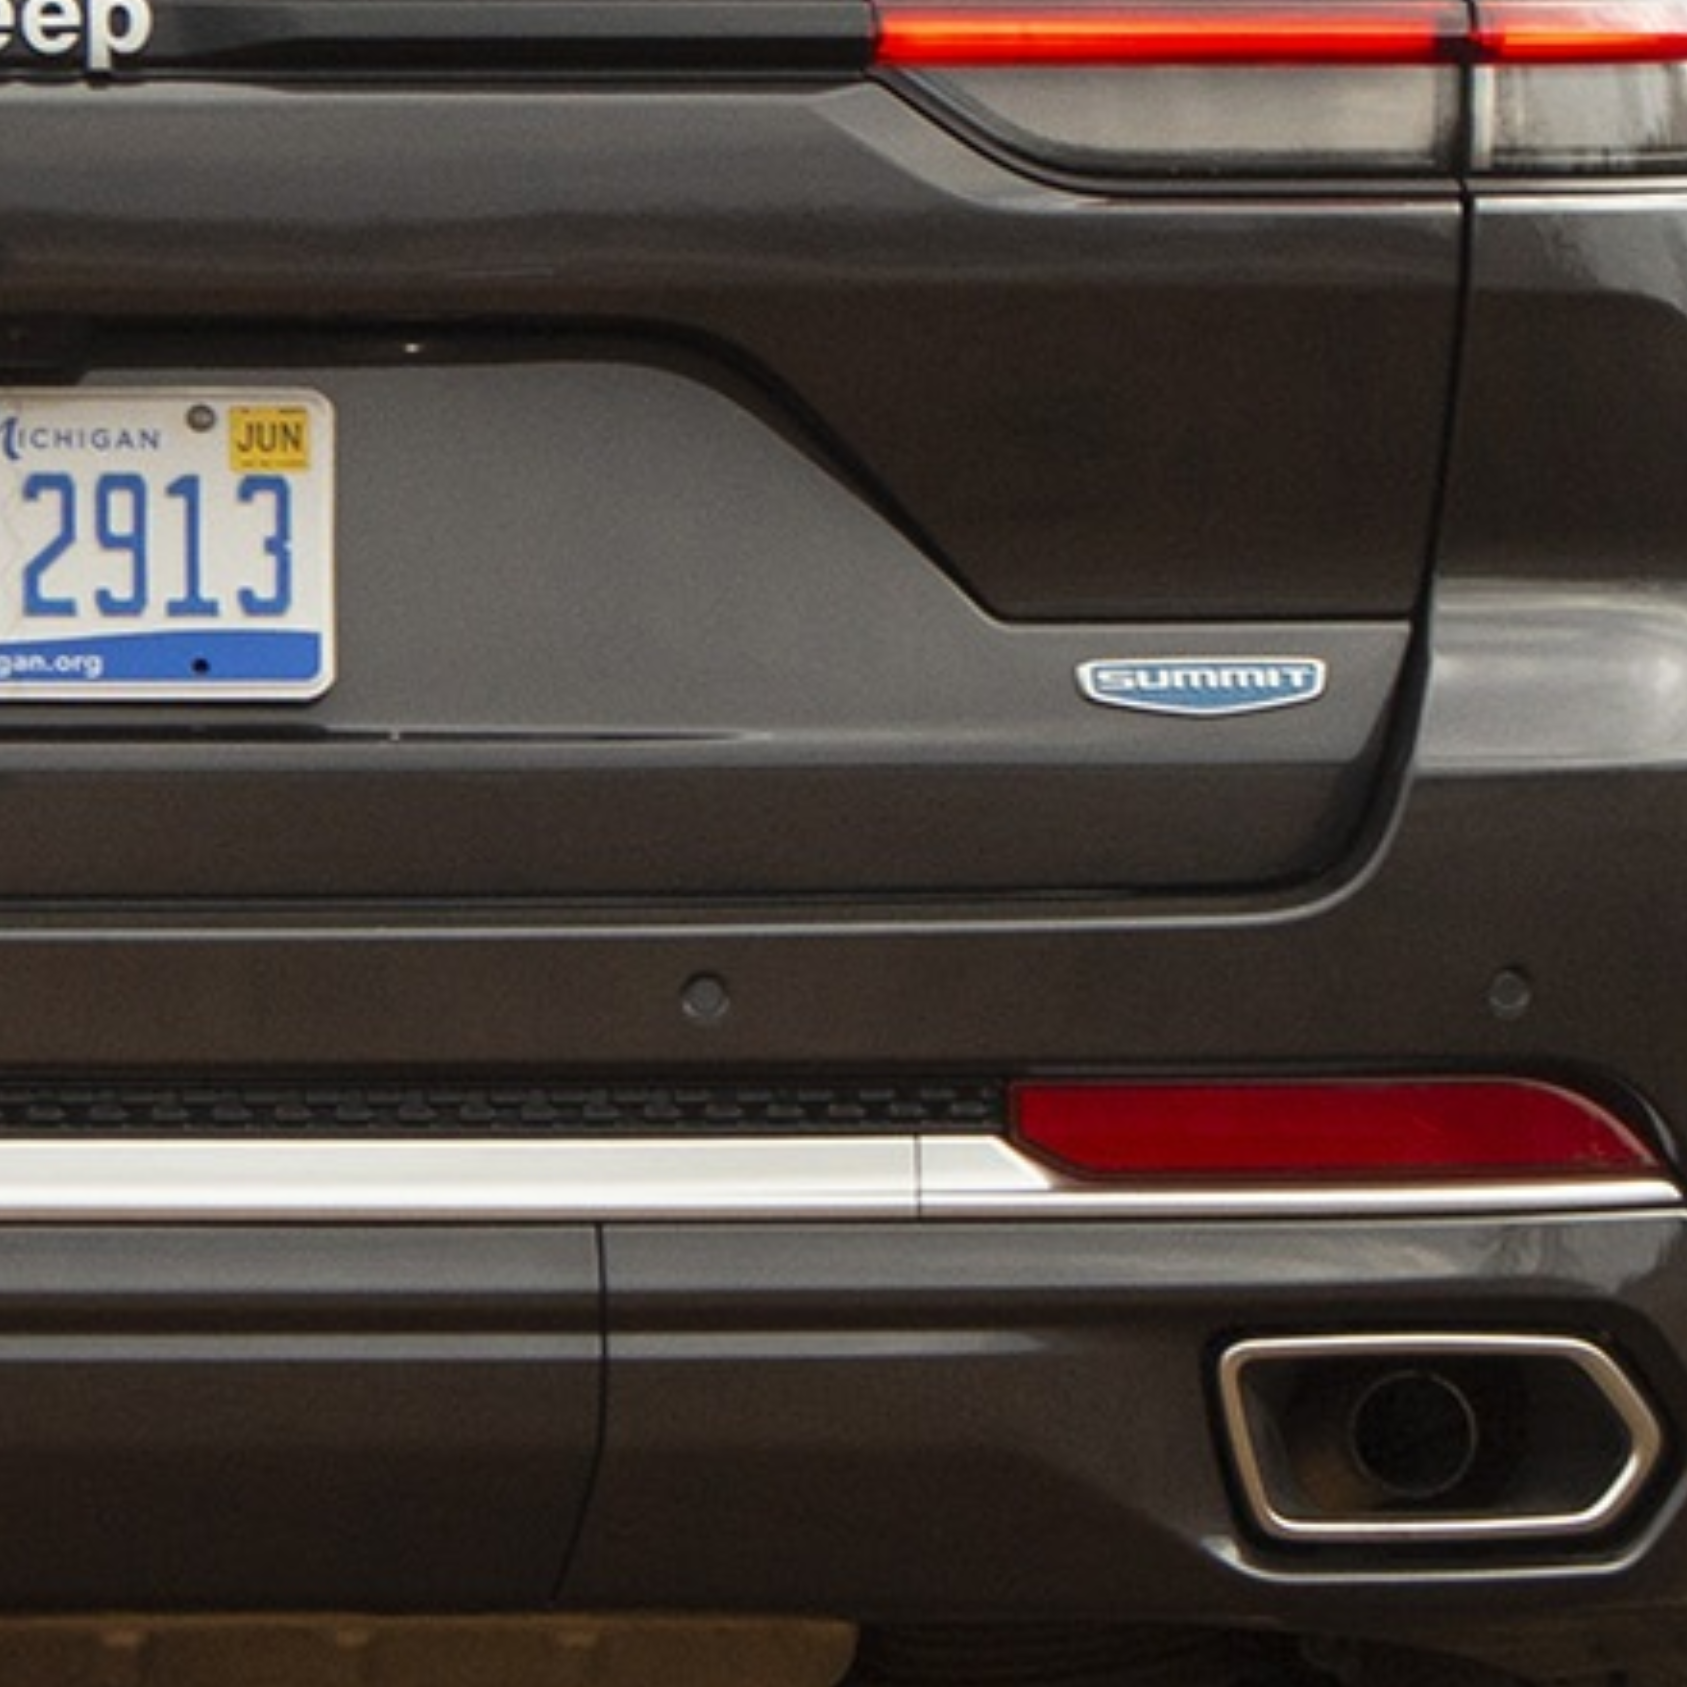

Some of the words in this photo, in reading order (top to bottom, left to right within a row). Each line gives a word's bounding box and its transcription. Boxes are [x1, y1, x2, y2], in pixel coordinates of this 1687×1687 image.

[236, 421, 304, 453] JUN
[20, 472, 292, 617] 2913
[1096, 668, 1313, 691] SUMMIT
